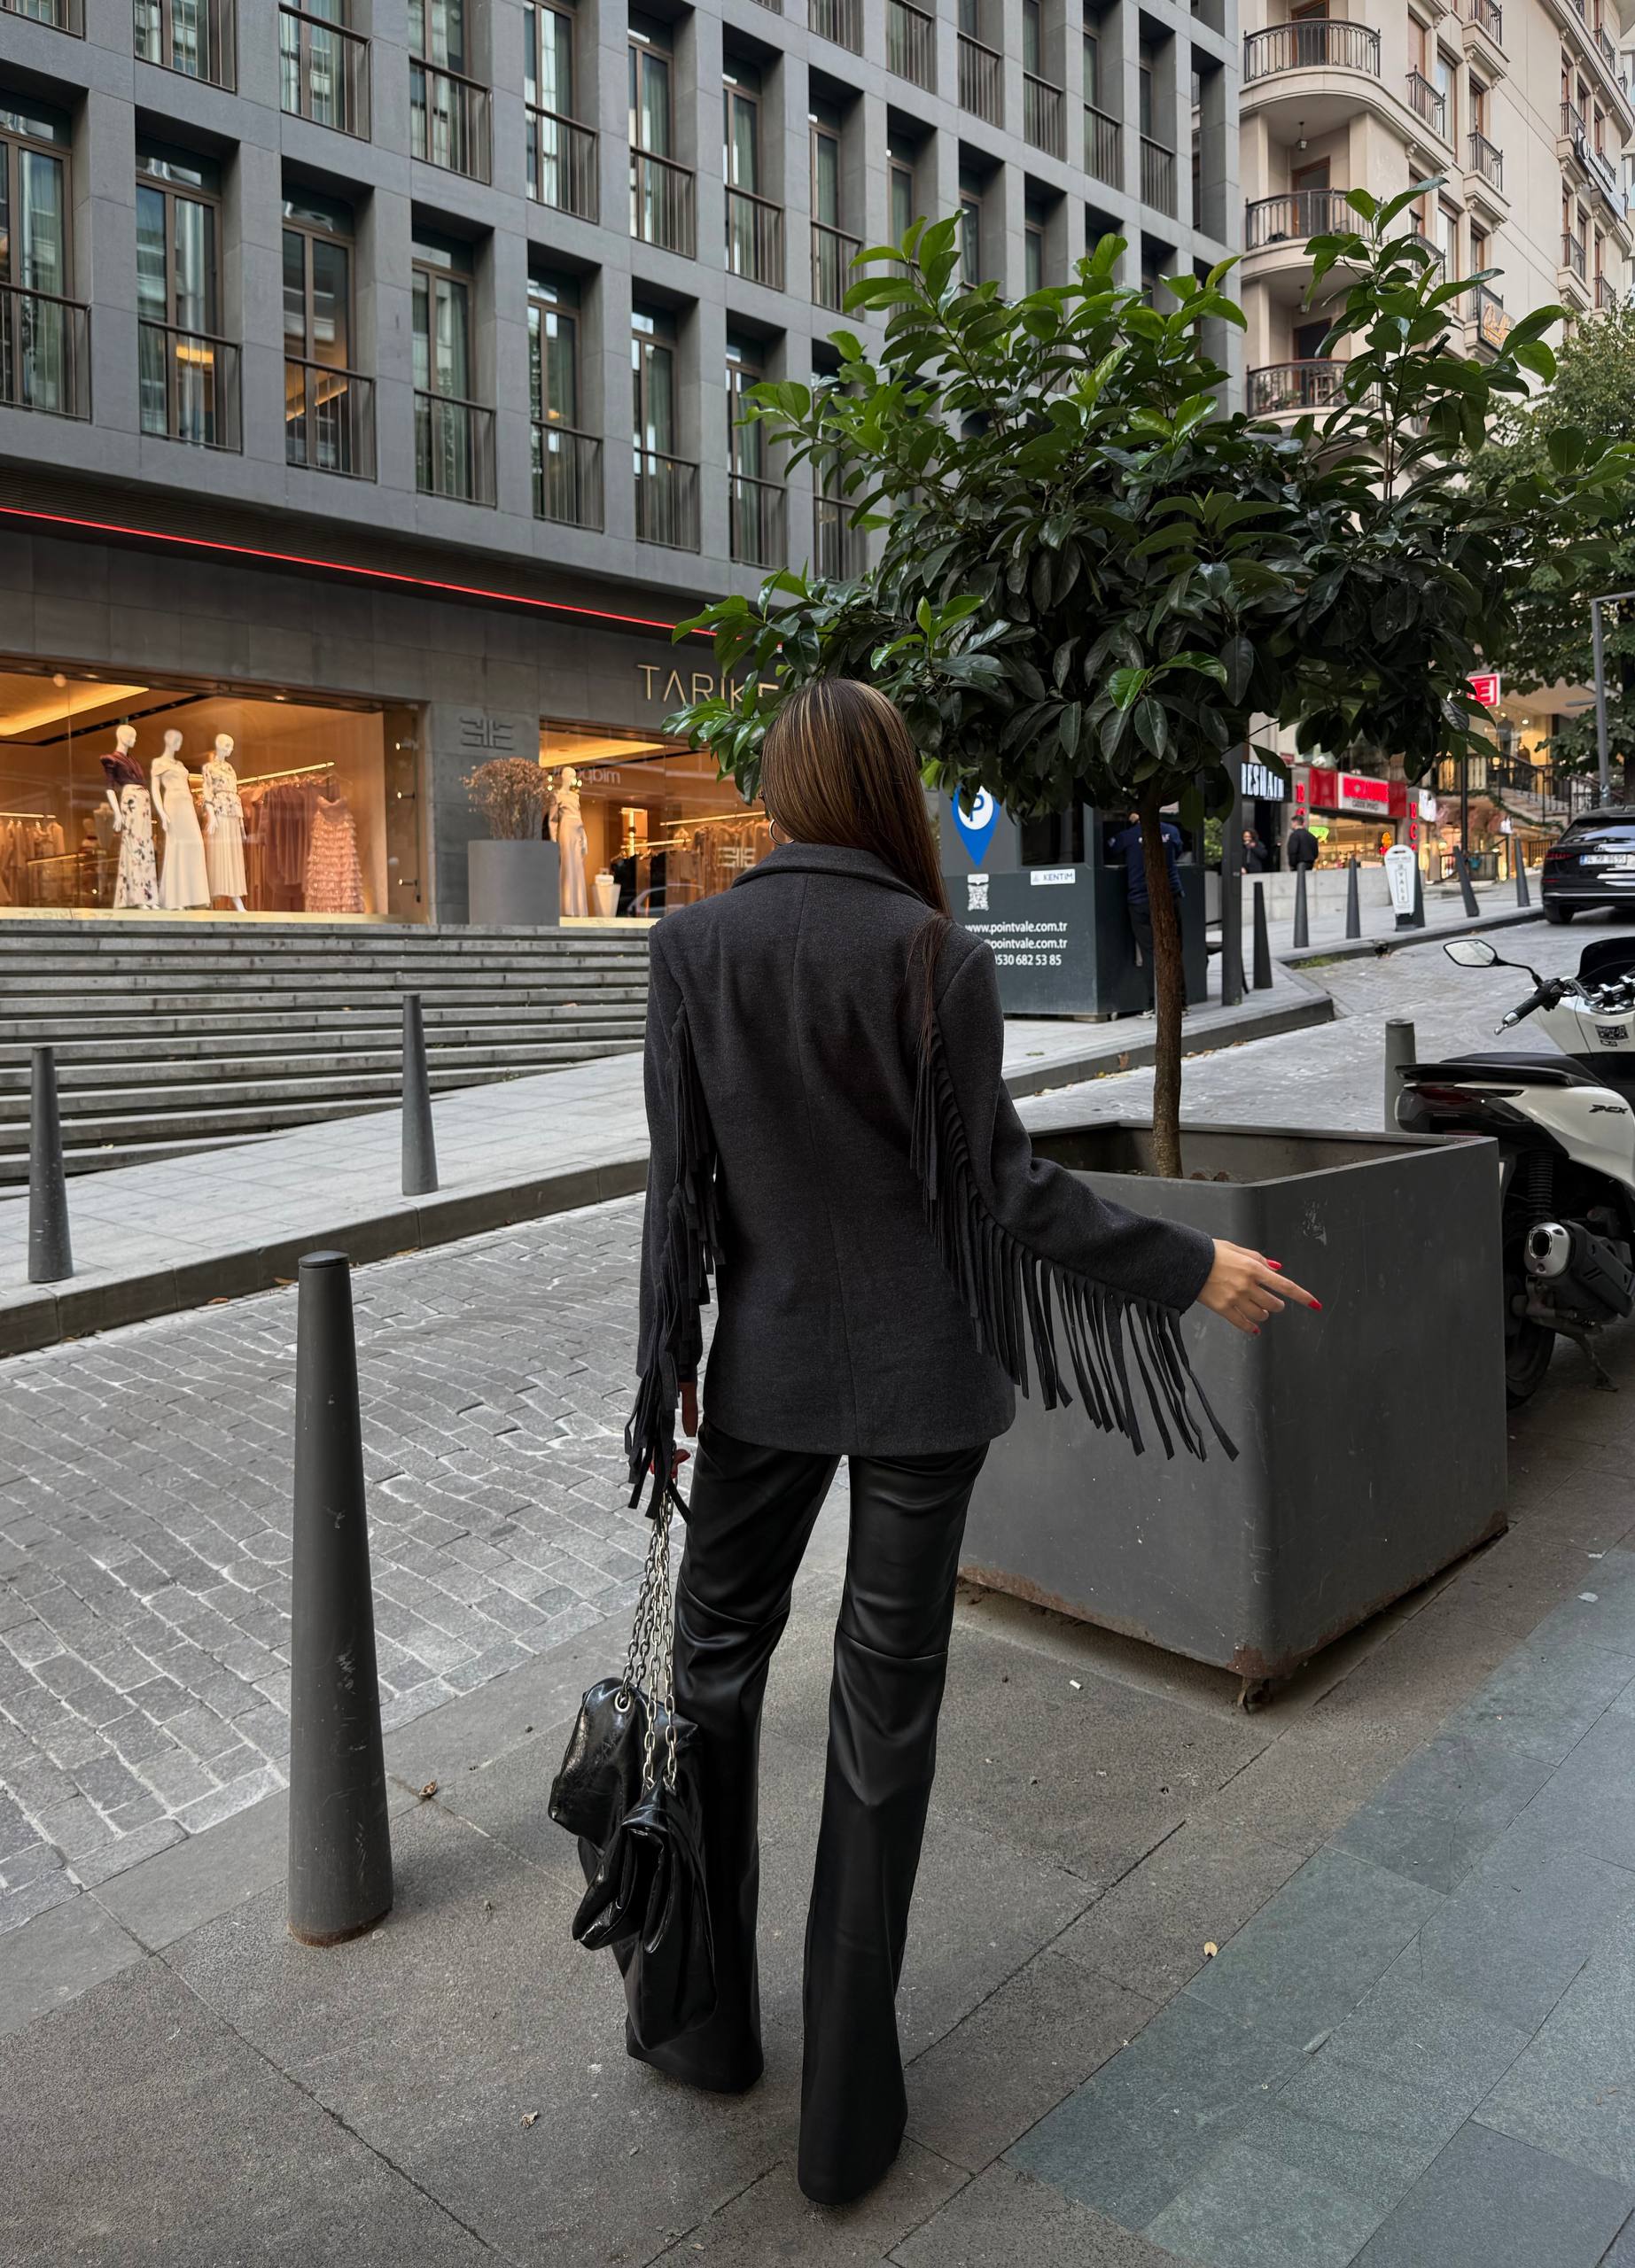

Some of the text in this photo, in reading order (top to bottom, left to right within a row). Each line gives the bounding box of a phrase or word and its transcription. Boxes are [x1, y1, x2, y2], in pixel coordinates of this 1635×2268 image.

[637, 664, 745, 711] TARIK
[965, 920, 1068, 936] www.pointvale.com.tr
[1016, 954, 1033, 966] 682
[1035, 954, 1047, 966] 53
[1048, 954, 1062, 966] 85
